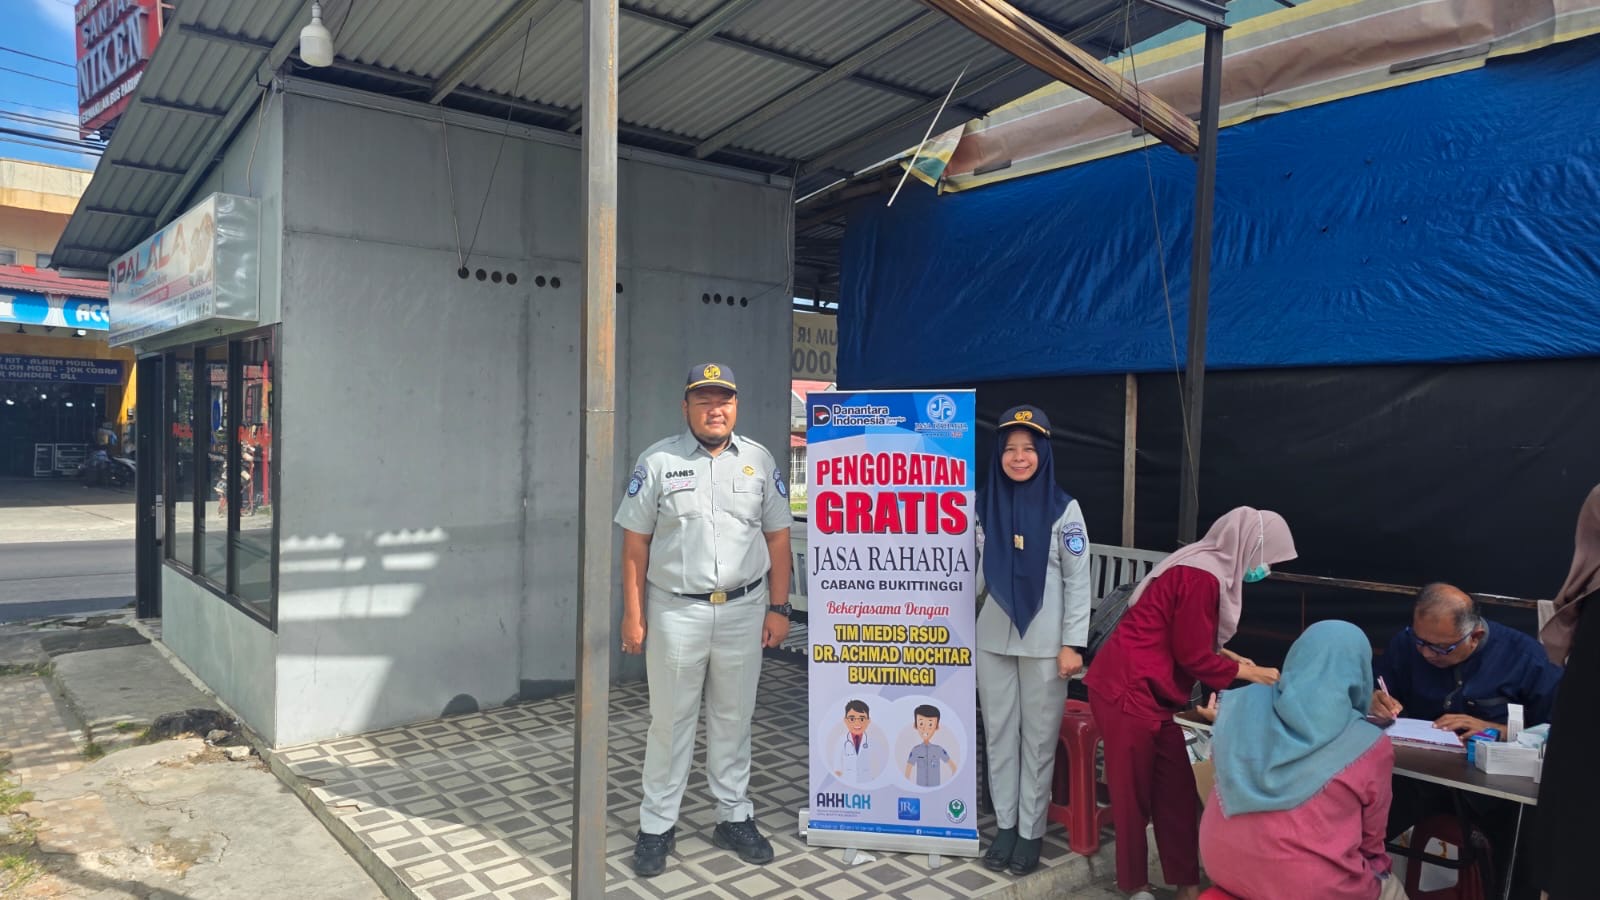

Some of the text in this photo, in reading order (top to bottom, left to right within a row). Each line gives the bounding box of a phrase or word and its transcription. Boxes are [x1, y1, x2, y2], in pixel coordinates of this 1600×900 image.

[82, 0, 137, 48] SANJA
[77, 6, 149, 105] NIKEN
[27, 365, 57, 373] MOBIL
[66, 360, 95, 368] MOBIL
[8, 371, 52, 379] MUNDUR
[833, 404, 889, 416] Danantara
[833, 414, 885, 426] Indonesia
[816, 452, 966, 486] PENGOBATAN
[815, 491, 968, 535] GRATIS
[813, 546, 970, 577] JASA RAHARJA
[821, 579, 963, 592] CABANG BUKITTINGGI
[826, 601, 949, 619] Bekerjasama Dengan
[834, 624, 950, 644] TIM MEDIS RSUD
[813, 644, 971, 666] DR. ACHMAD MOCHTAR
[848, 665, 936, 686] BUKITTINGGI
[816, 792, 871, 810] AKHLAK
